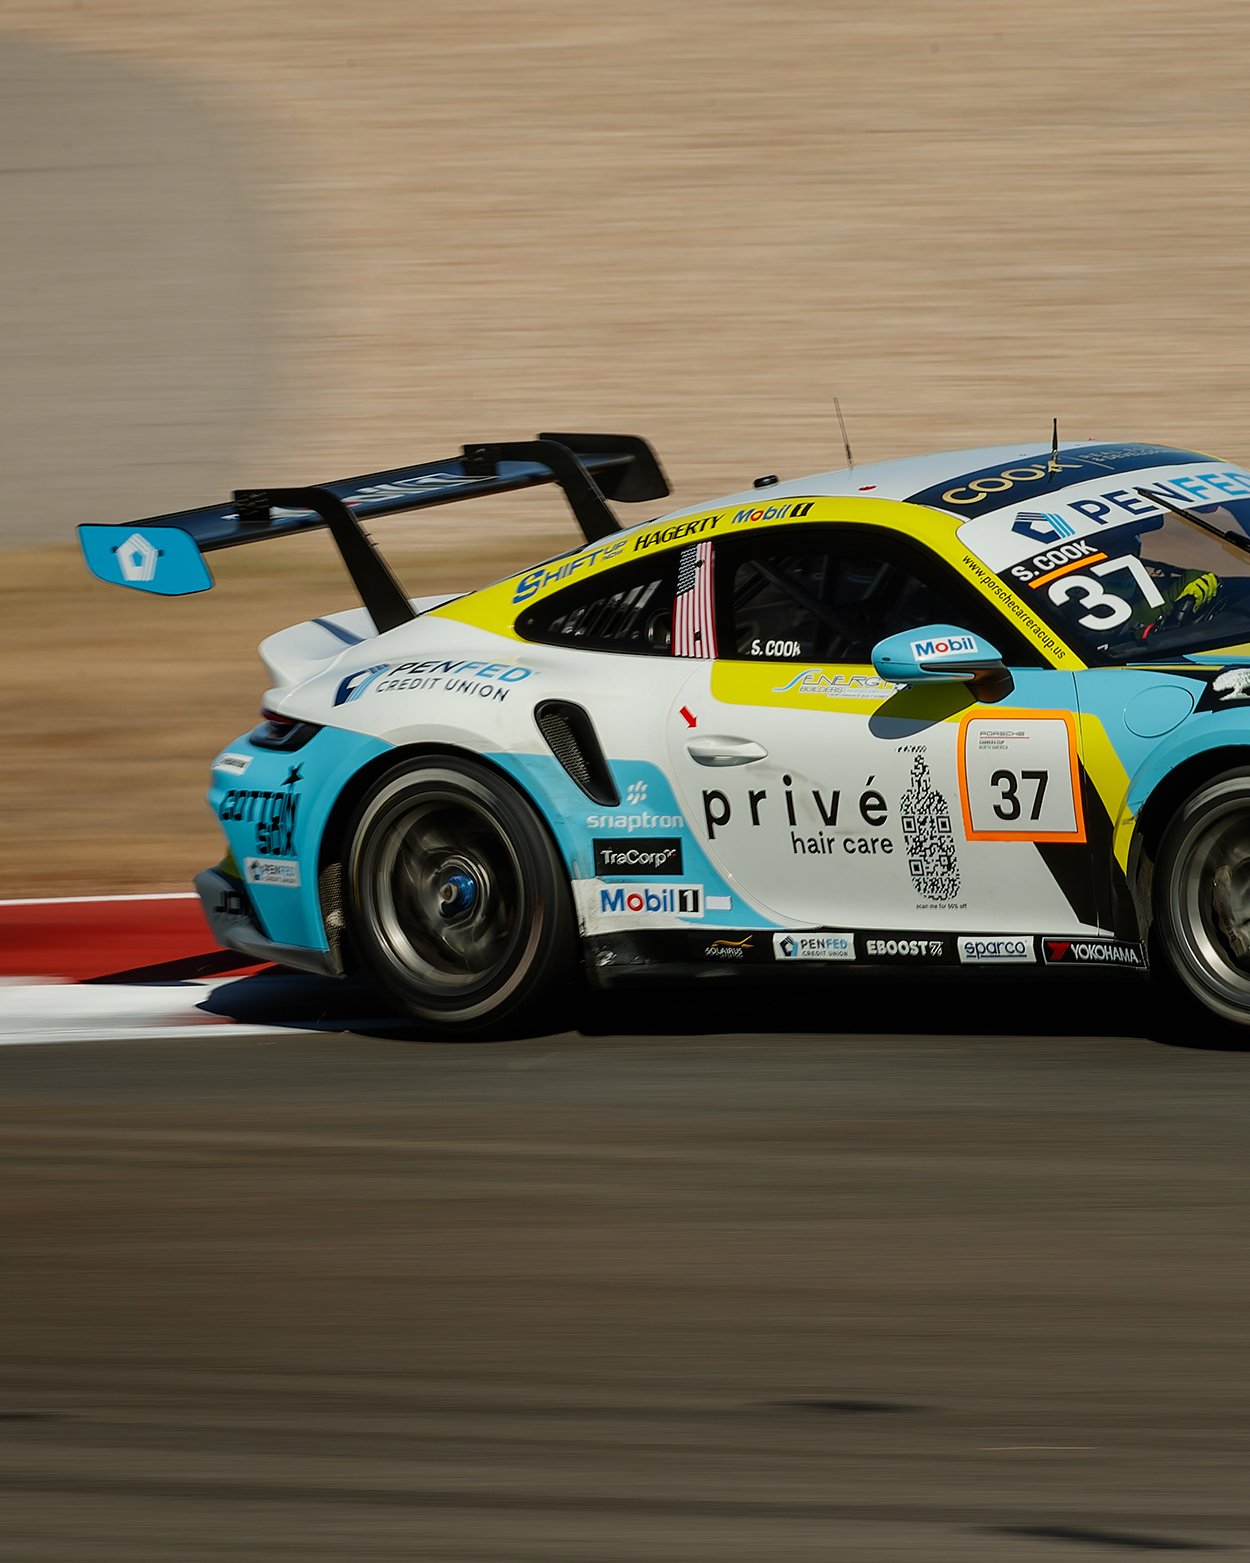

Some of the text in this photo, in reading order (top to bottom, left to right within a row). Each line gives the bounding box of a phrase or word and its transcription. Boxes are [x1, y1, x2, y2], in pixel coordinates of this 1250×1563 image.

[731, 502, 815, 525] Mobil 1
[633, 514, 725, 552] HAGERTY
[1011, 540, 1099, 582] S. COOK
[1048, 554, 1166, 631] 37
[962, 555, 1067, 660] www.porschecarreracup.us
[751, 639, 763, 656] S.
[914, 637, 975, 657] Mobil
[388, 660, 532, 684] PENFED
[376, 678, 511, 702] CREDIT UNION
[702, 774, 888, 840] privé
[990, 769, 1049, 821] 37
[586, 811, 684, 833] snaptron
[791, 830, 894, 855] hair care
[600, 849, 667, 868] TraCorp
[601, 888, 700, 914] Mobil 1
[801, 938, 849, 950] PENFED
[866, 940, 929, 957] EBOOST
[964, 941, 1026, 960] sparco
[1070, 943, 1140, 964] YOKOHAMA
